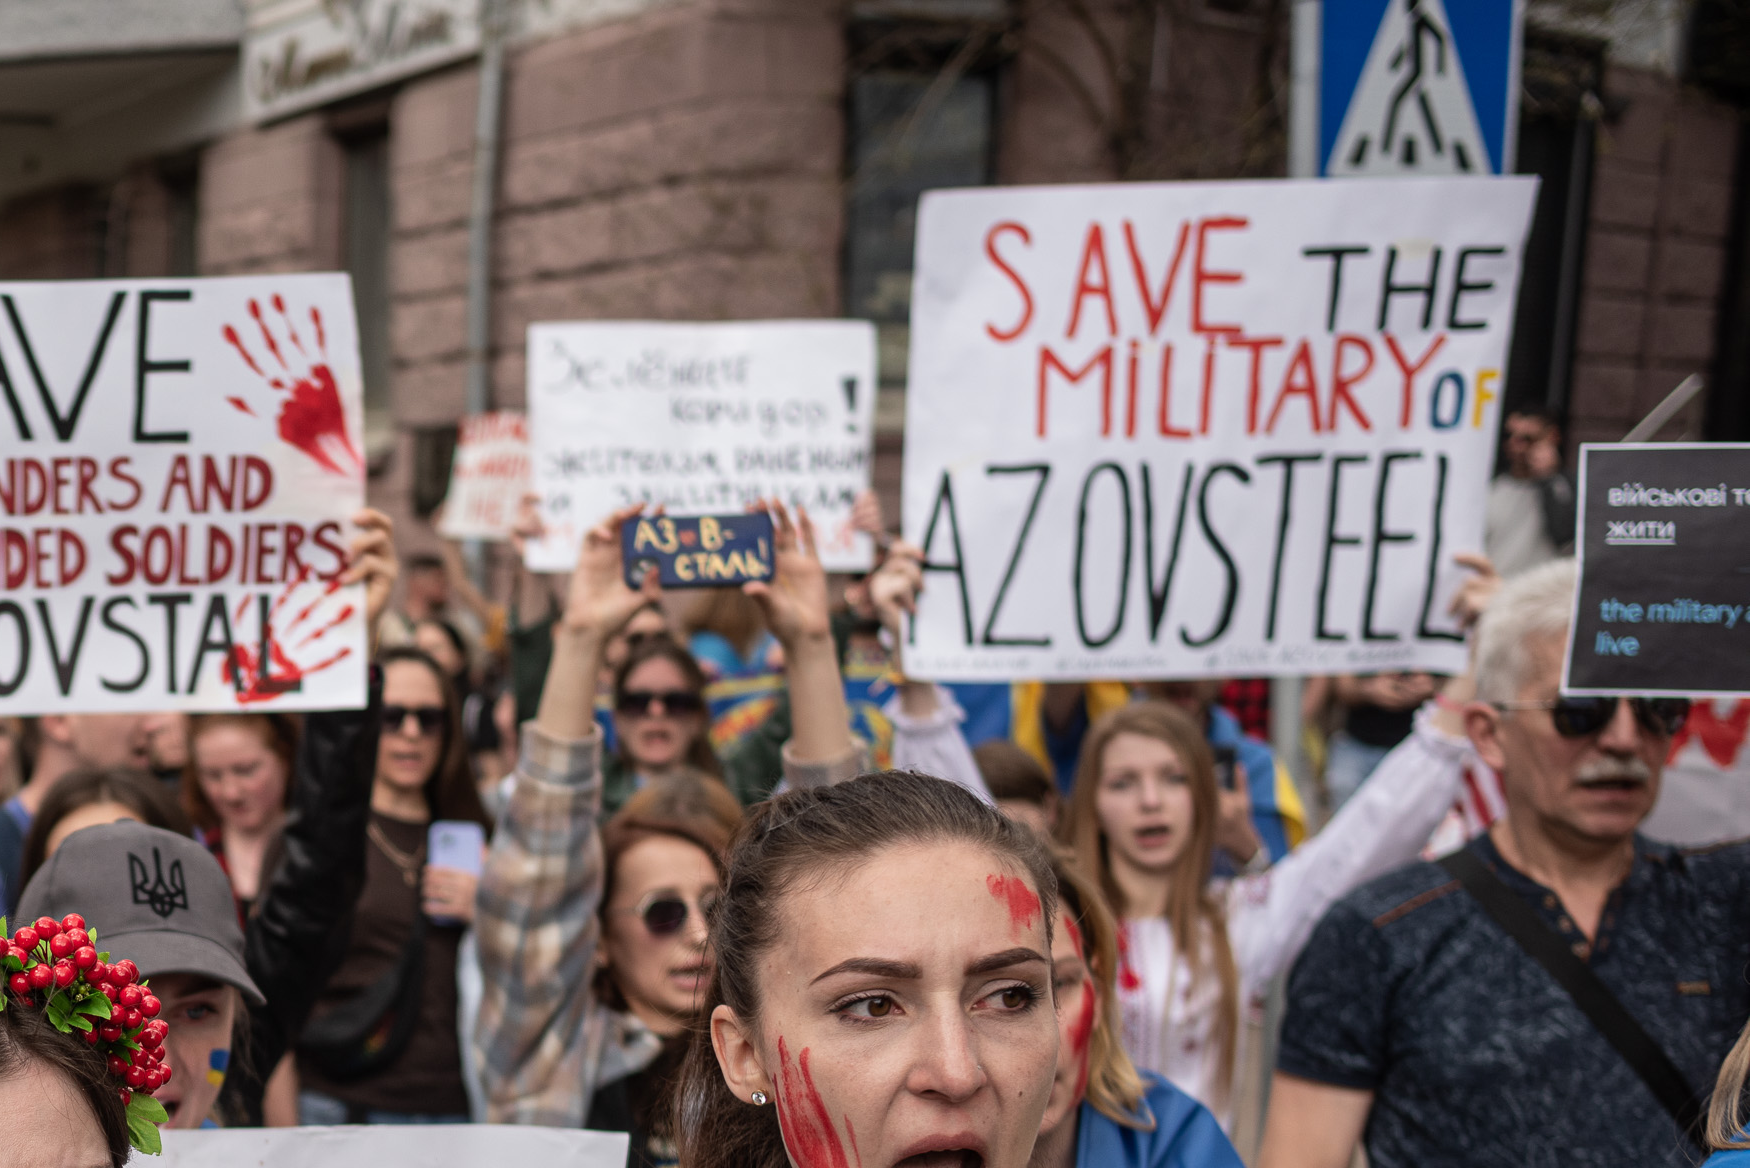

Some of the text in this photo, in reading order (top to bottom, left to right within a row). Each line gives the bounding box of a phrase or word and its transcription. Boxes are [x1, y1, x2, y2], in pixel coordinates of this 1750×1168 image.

[985, 216, 1506, 343] SAVE THE
[1427, 368, 1499, 430] OF
[159, 454, 274, 515] AND
[1732, 486, 1750, 506] т
[106, 520, 350, 587] SOLDIERS
[907, 451, 1466, 648] AZOVSTEEL
[1600, 598, 1743, 628] the military
[1595, 631, 1641, 657] live
